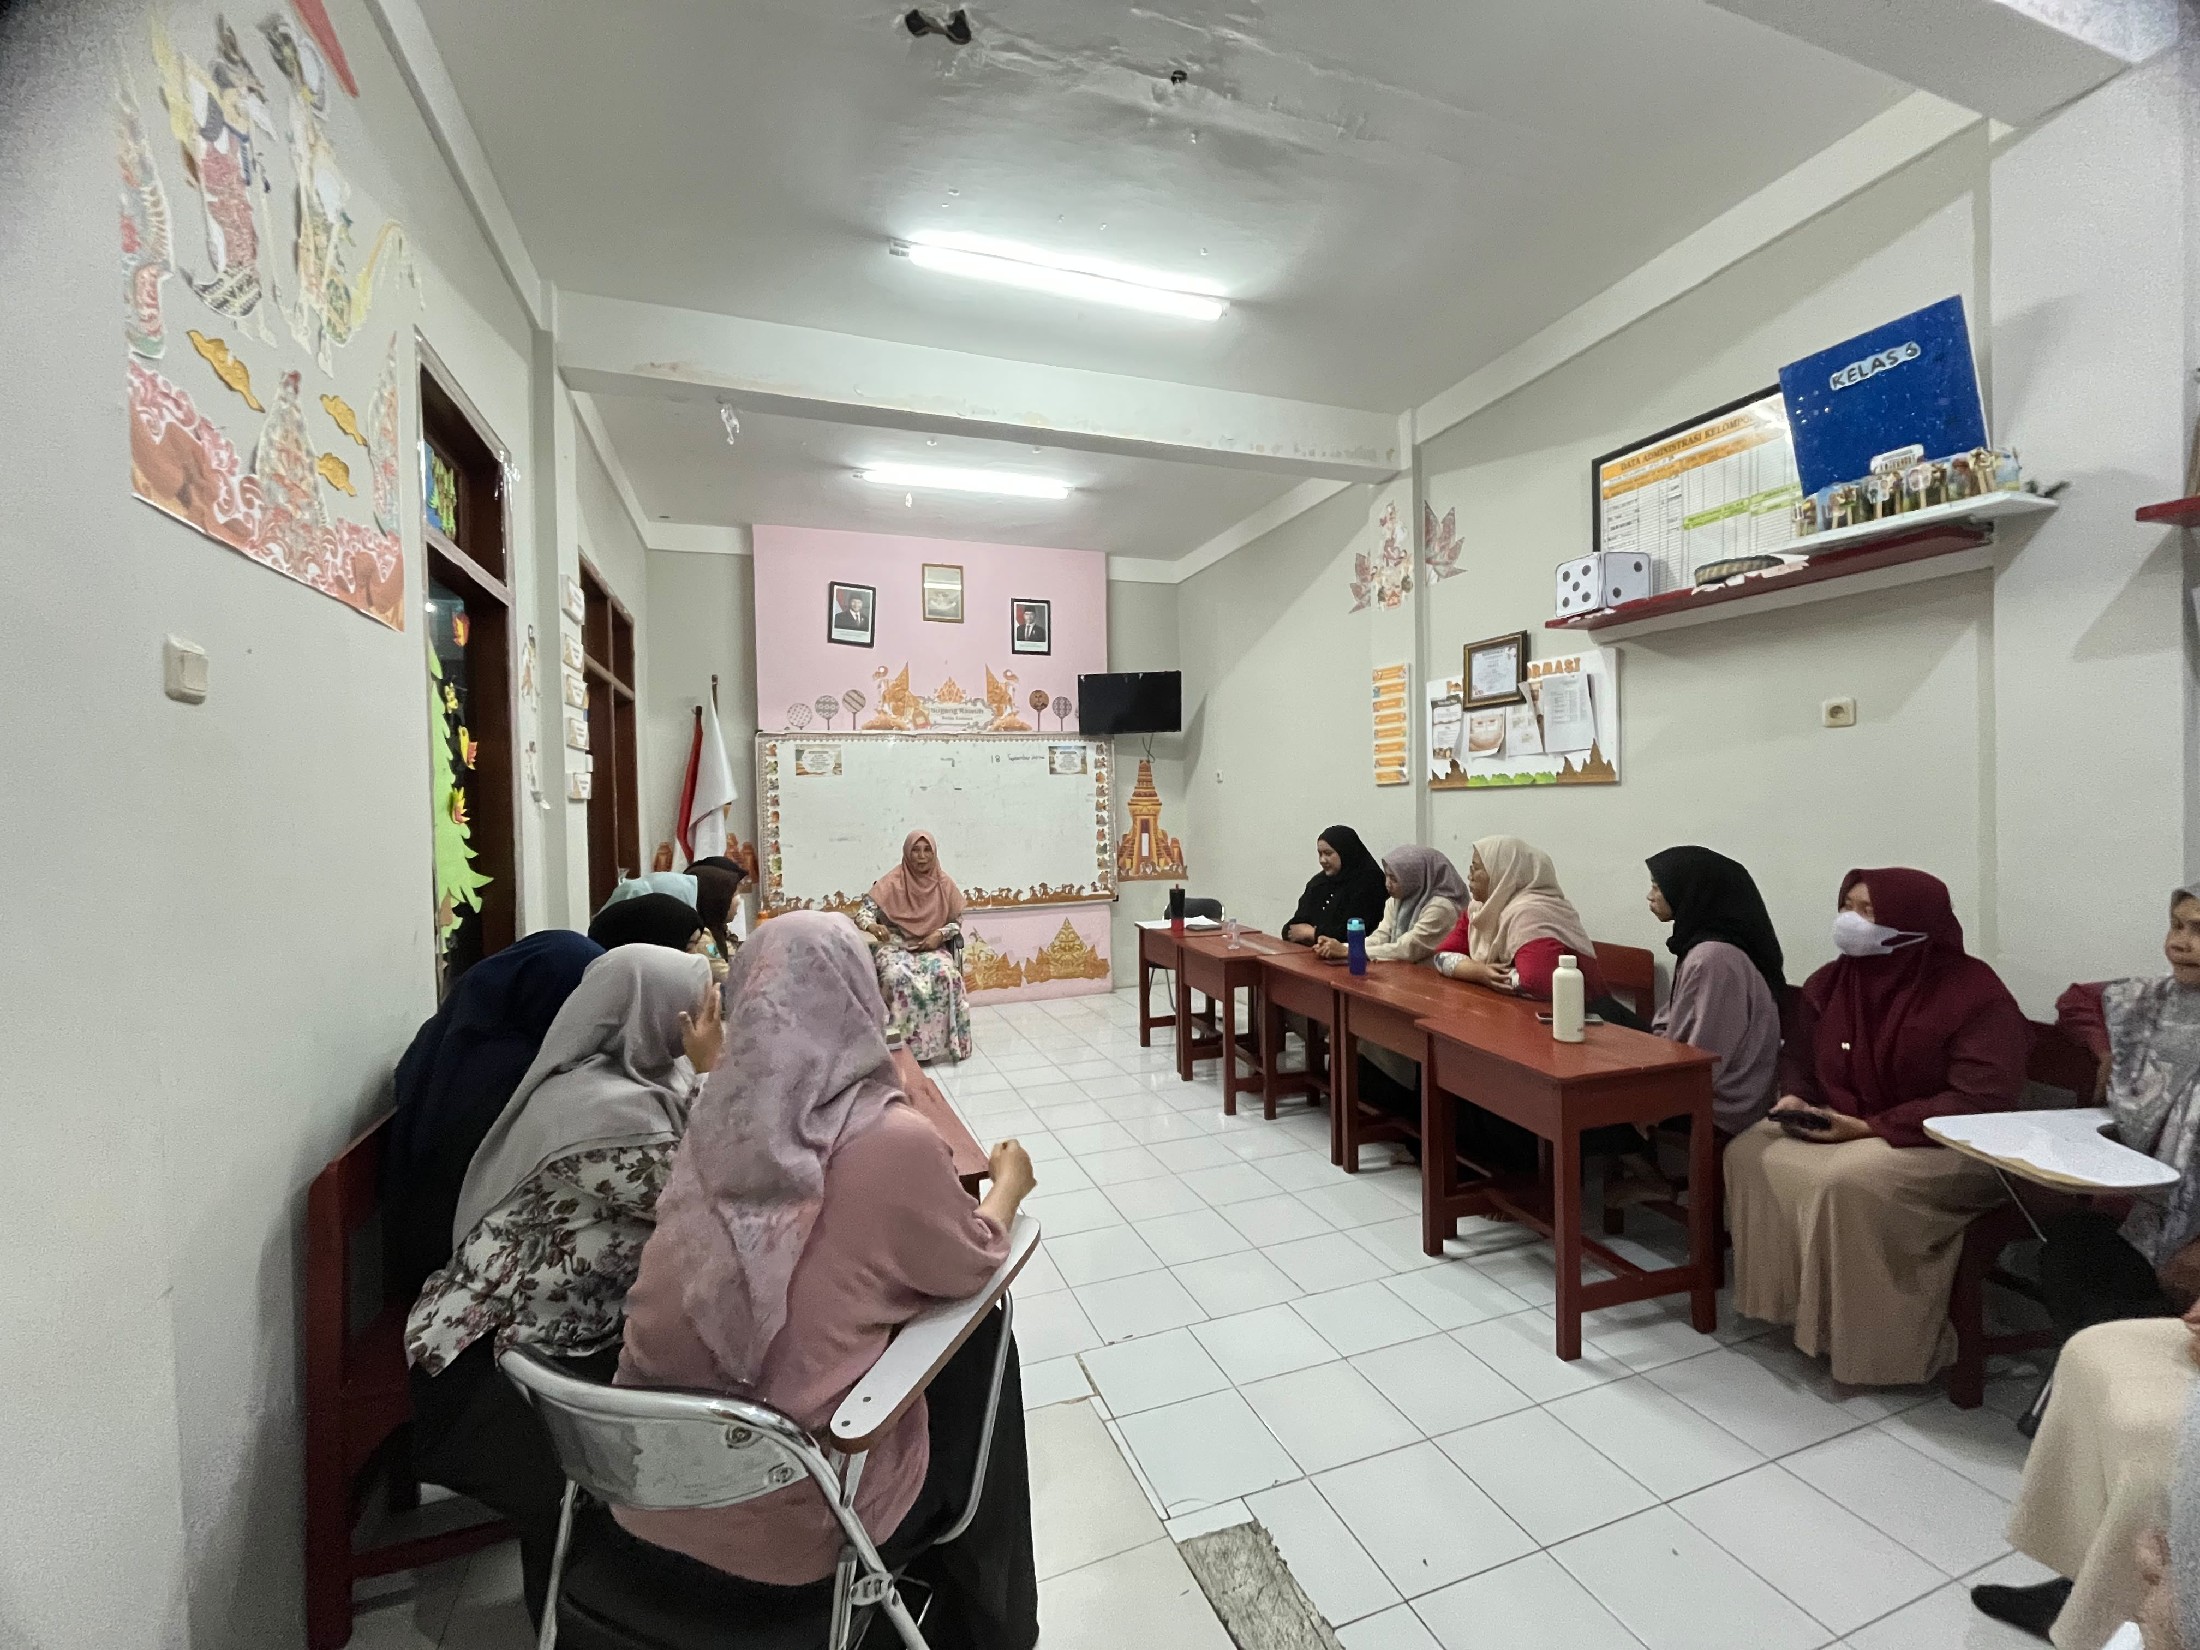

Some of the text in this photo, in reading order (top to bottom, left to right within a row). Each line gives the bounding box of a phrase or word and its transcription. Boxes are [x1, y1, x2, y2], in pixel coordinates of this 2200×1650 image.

[1832, 350, 1899, 389] KELAS
[1621, 457, 1641, 471] DATA
[1643, 433, 1702, 463] ADMINISTRASI
[1704, 413, 1753, 440] KELOMPO
